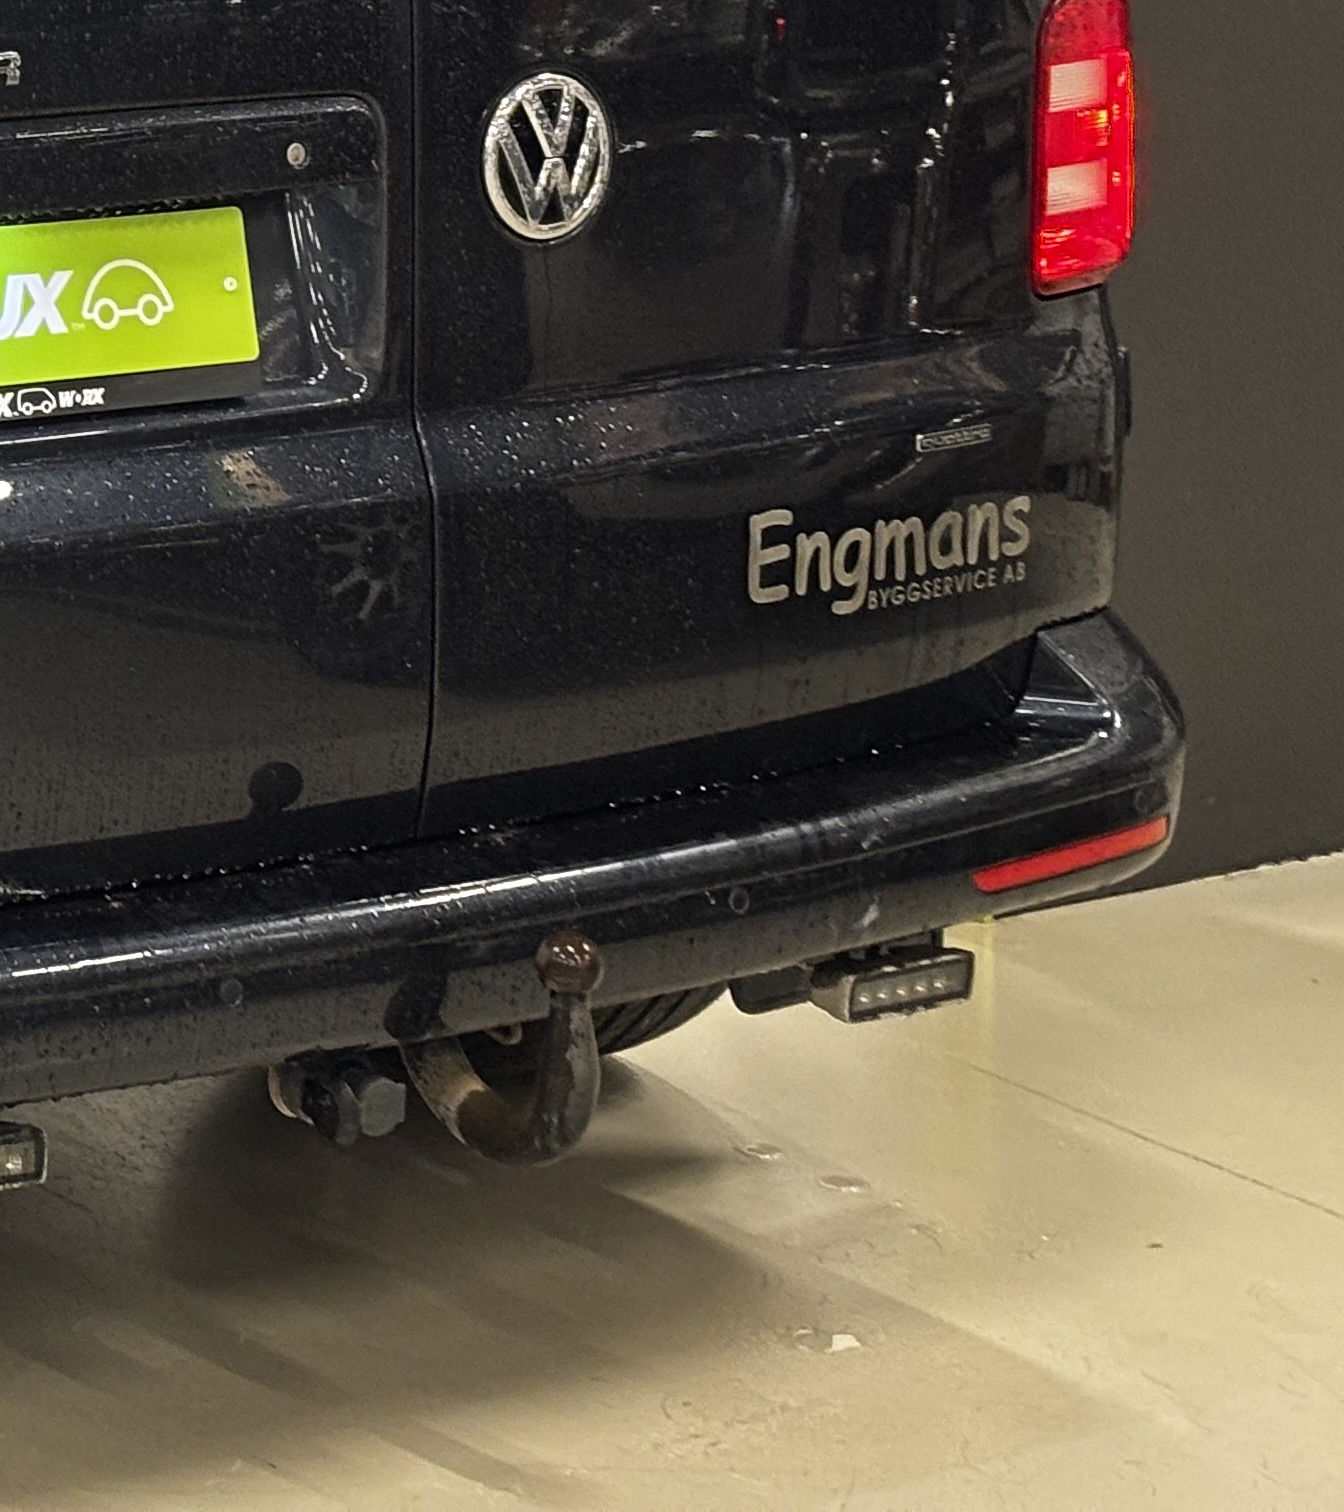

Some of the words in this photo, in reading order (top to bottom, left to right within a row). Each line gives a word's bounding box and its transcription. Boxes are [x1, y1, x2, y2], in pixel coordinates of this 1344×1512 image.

[748, 495, 1032, 615] Engmans
[867, 567, 998, 610] BYGGSERVICE
[1003, 561, 1027, 585] AB
